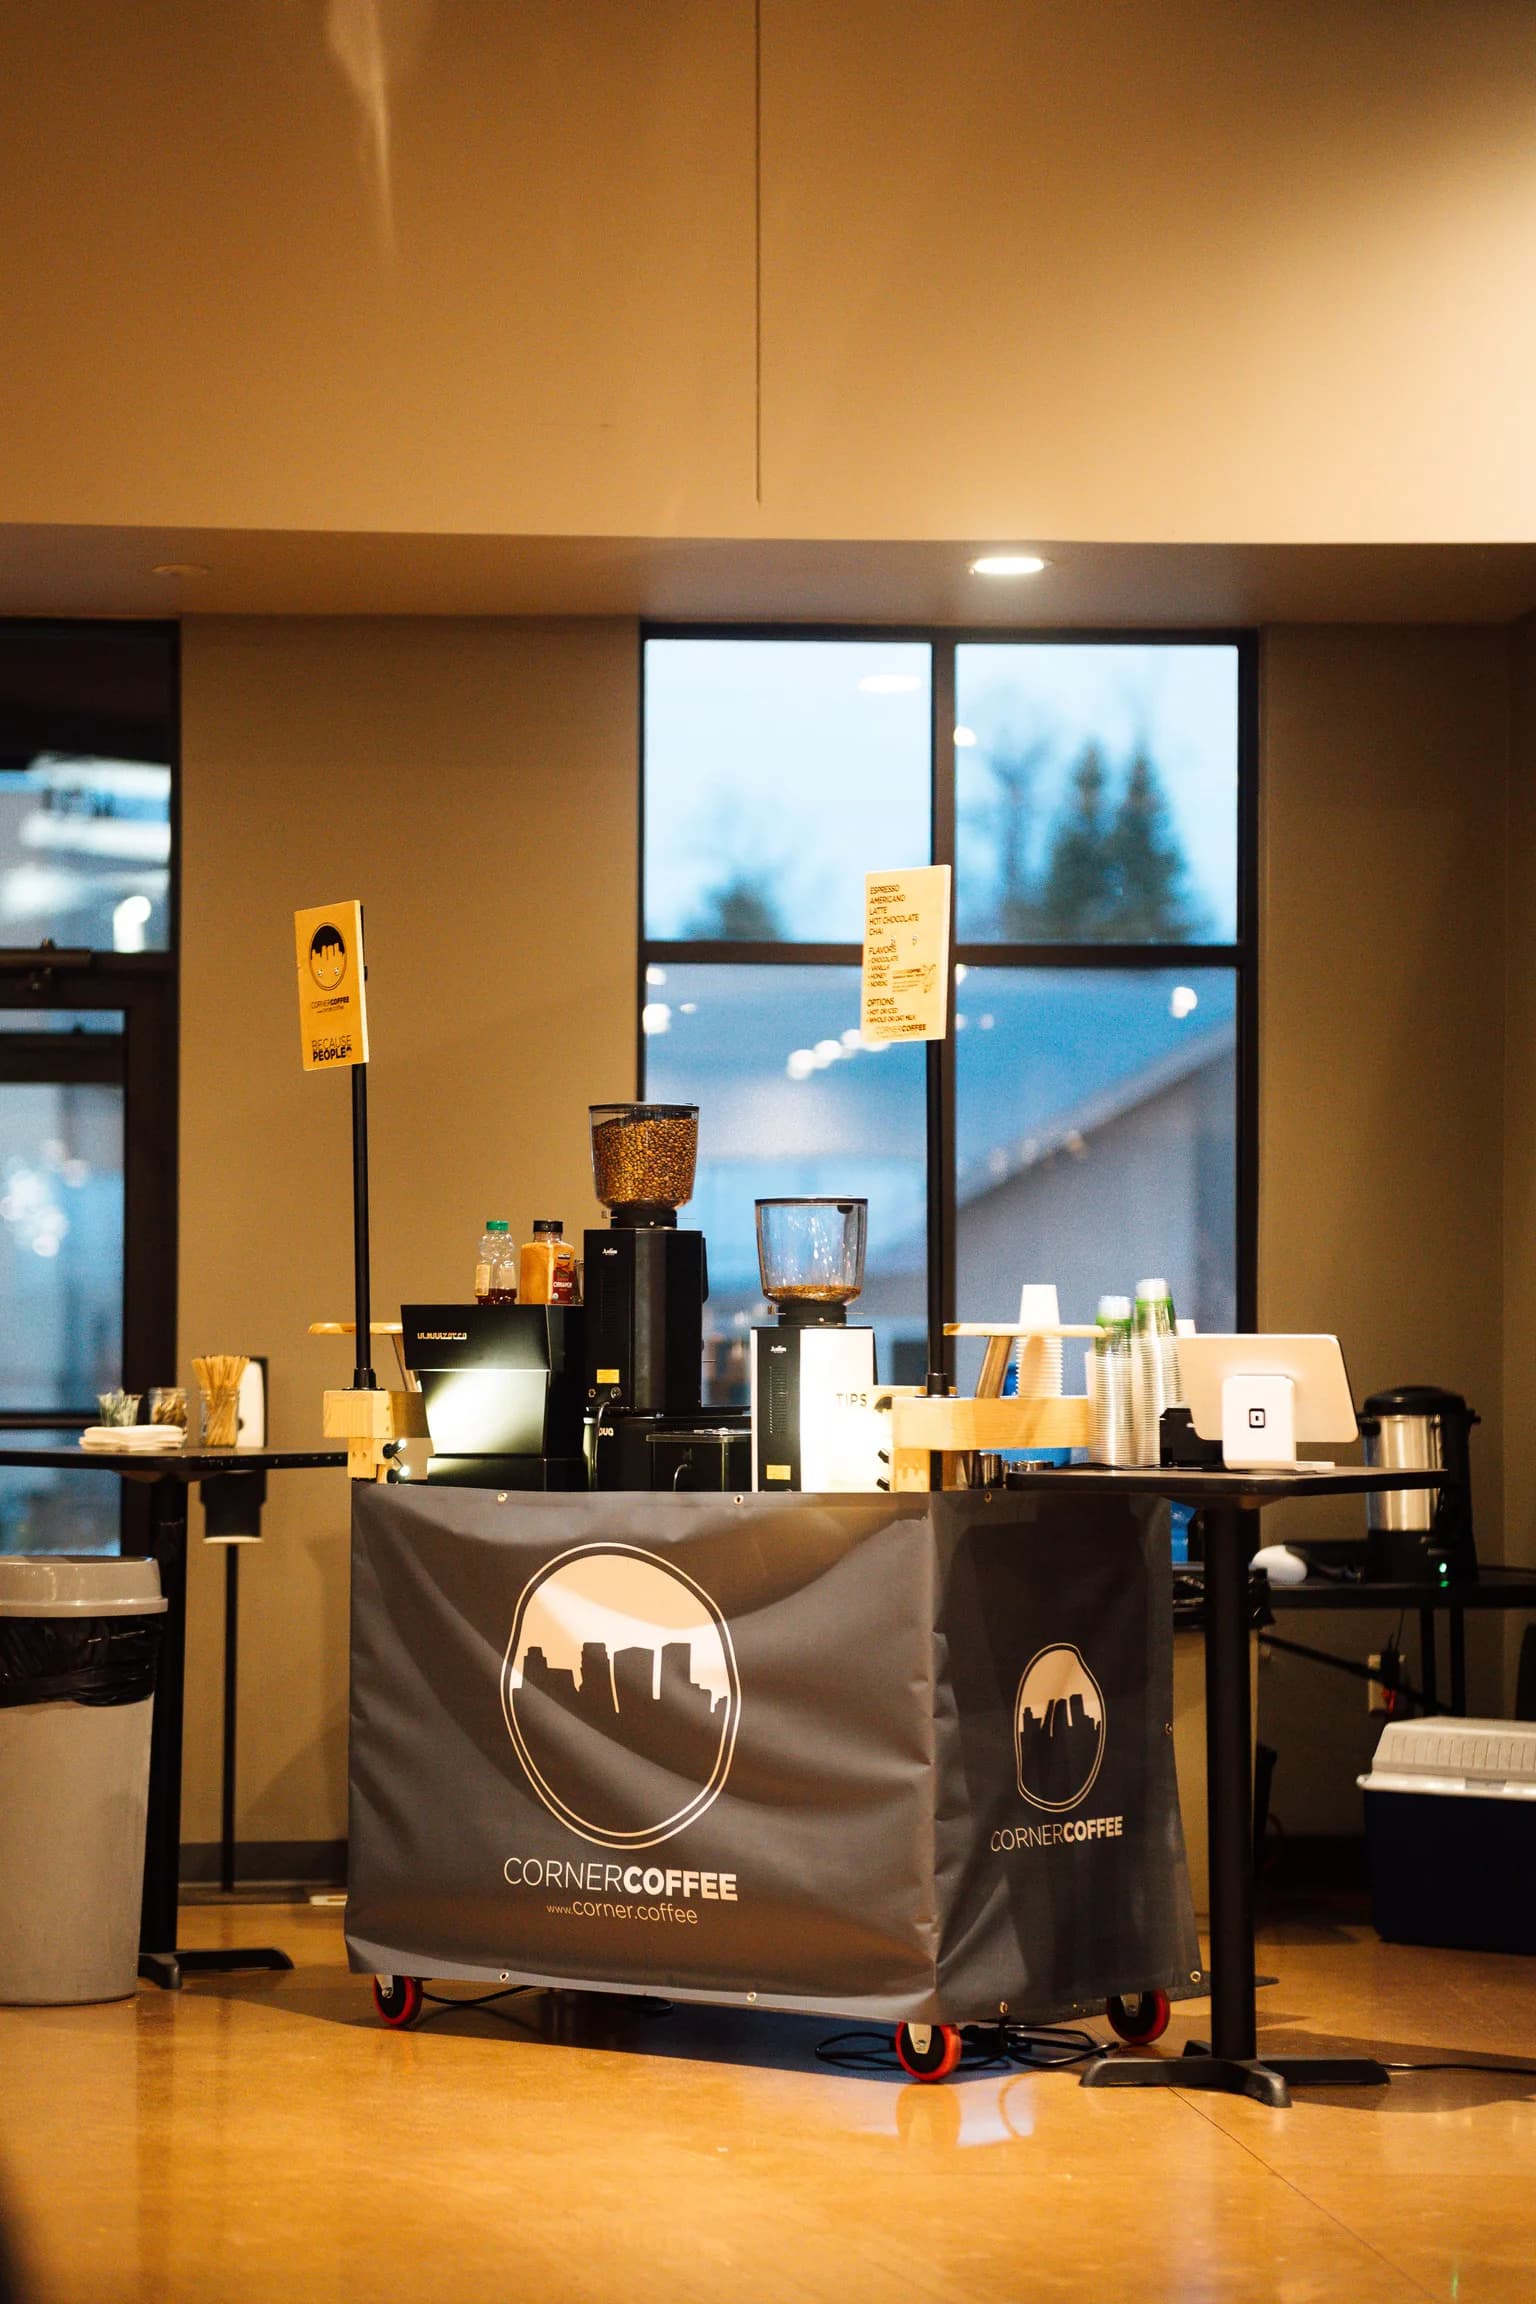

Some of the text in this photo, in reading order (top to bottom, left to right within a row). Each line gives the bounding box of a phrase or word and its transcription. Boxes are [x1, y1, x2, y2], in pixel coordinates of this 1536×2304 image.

[870, 884, 899, 894] ESPRESSO
[869, 894, 905, 904] AMERICANO
[869, 906, 887, 915] LATTE
[869, 914, 919, 926] HOT CHOCOLATE
[868, 928, 884, 936] CHAI
[867, 997, 895, 1007] OPTIONS
[312, 1034, 352, 1048] BECAUSE
[836, 1393, 868, 1407] TIPS
[991, 1815, 1123, 1852] CORNERCOFFEE
[503, 1857, 739, 1902] CORNERCOFFEE
[546, 1901, 698, 1924] www.corner.coffee
